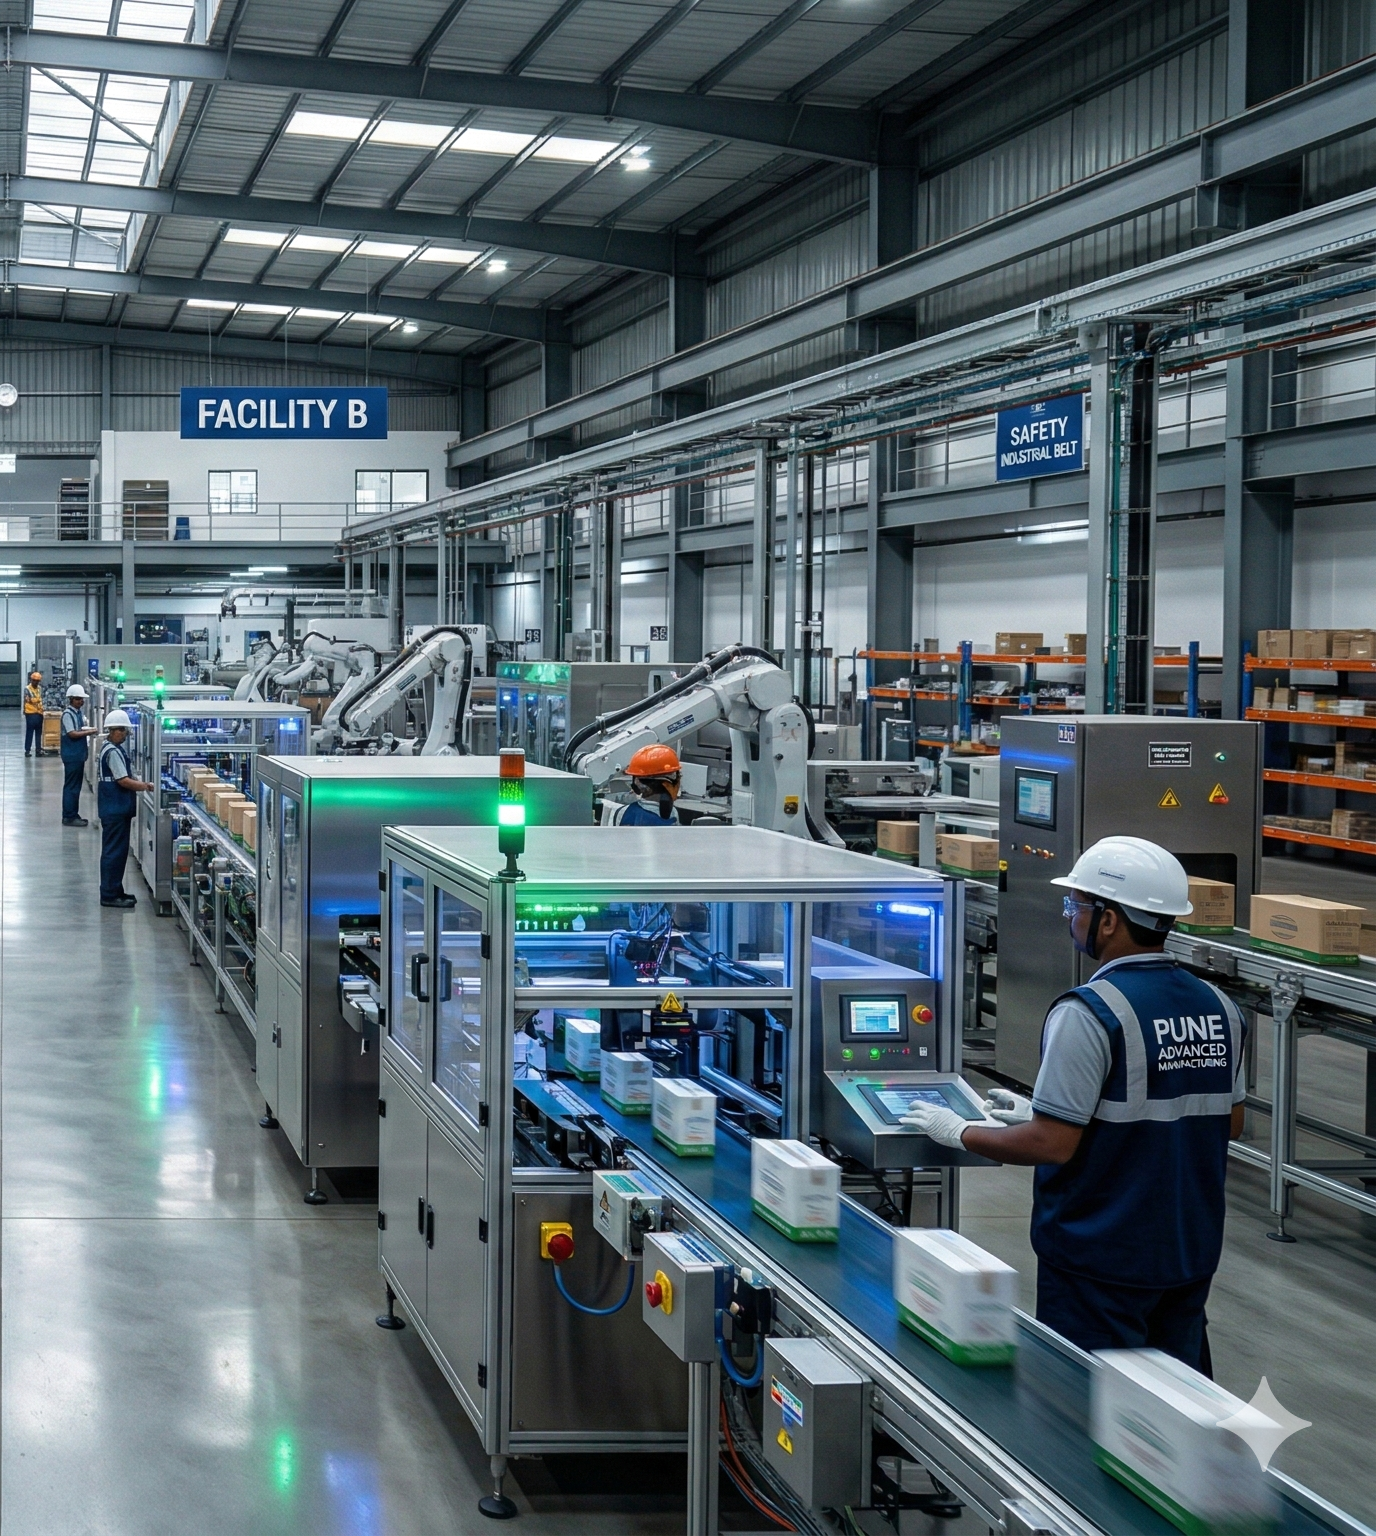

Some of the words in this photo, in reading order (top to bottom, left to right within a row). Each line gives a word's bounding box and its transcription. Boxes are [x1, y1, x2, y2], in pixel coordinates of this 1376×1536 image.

[198, 399, 338, 429] FACILITY
[348, 399, 368, 429] B
[1010, 416, 1068, 446] SAFETY
[1054, 441, 1078, 458] BELT
[1153, 1014, 1225, 1045] PUNE
[1158, 1043, 1227, 1060] ADVANCED
